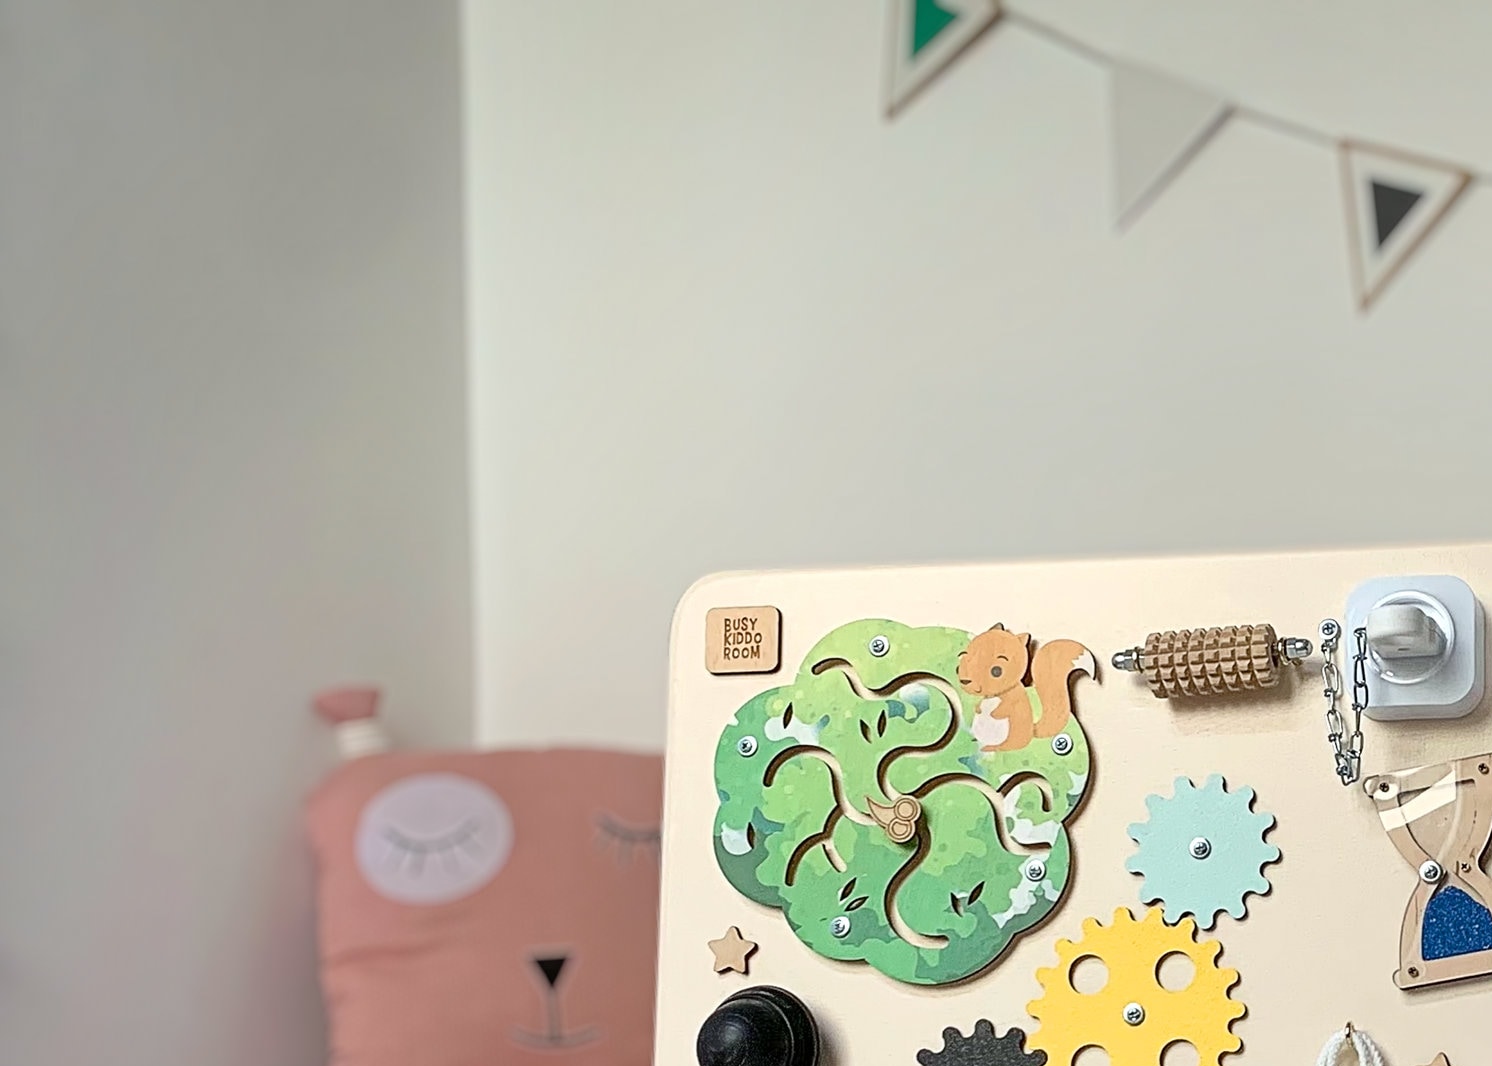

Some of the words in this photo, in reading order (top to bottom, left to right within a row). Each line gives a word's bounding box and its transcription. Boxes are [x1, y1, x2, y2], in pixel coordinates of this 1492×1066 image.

[724, 617, 758, 632] BUSY
[724, 632, 762, 646] KIDDO
[723, 645, 760, 660] ROOM
